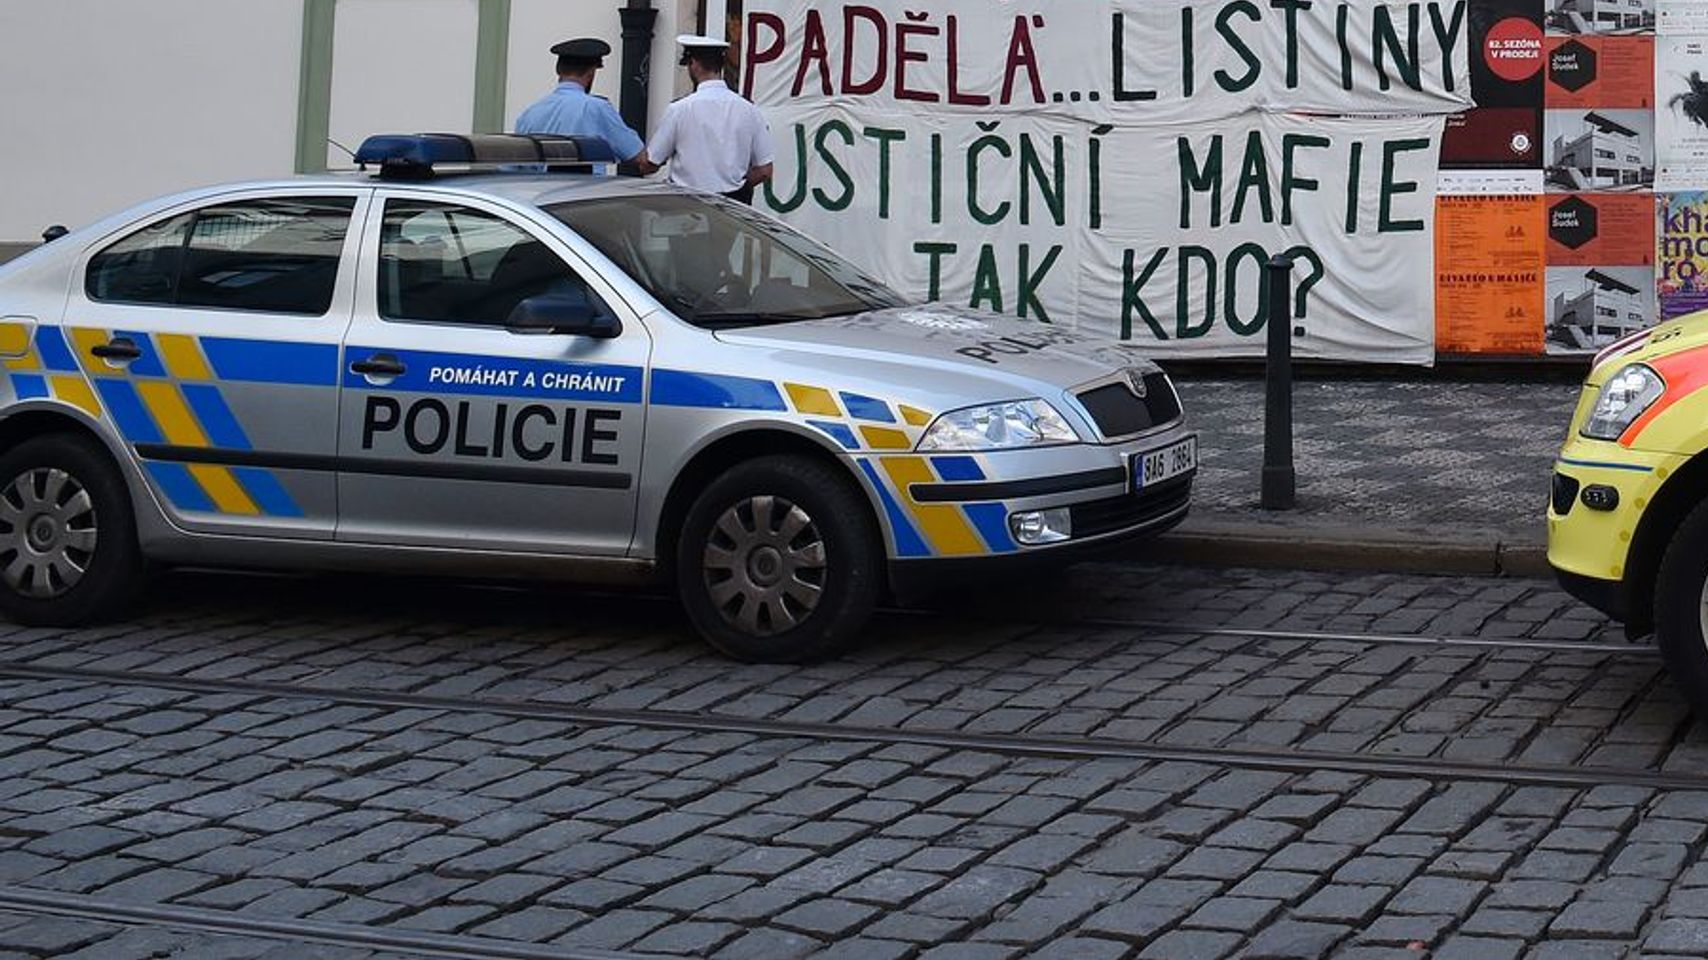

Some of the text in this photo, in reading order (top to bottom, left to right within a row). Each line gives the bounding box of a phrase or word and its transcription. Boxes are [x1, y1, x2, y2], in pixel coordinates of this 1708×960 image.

[1552, 54, 1576, 63] Josef
[763, 119, 1431, 233] USTIČNÍ MAFIE
[1552, 210, 1577, 219] Josef
[914, 241, 1325, 340] TAK KDO?
[429, 365, 625, 393] POMÁHAT A CHRÁNIT
[362, 396, 622, 466] POLICIE
